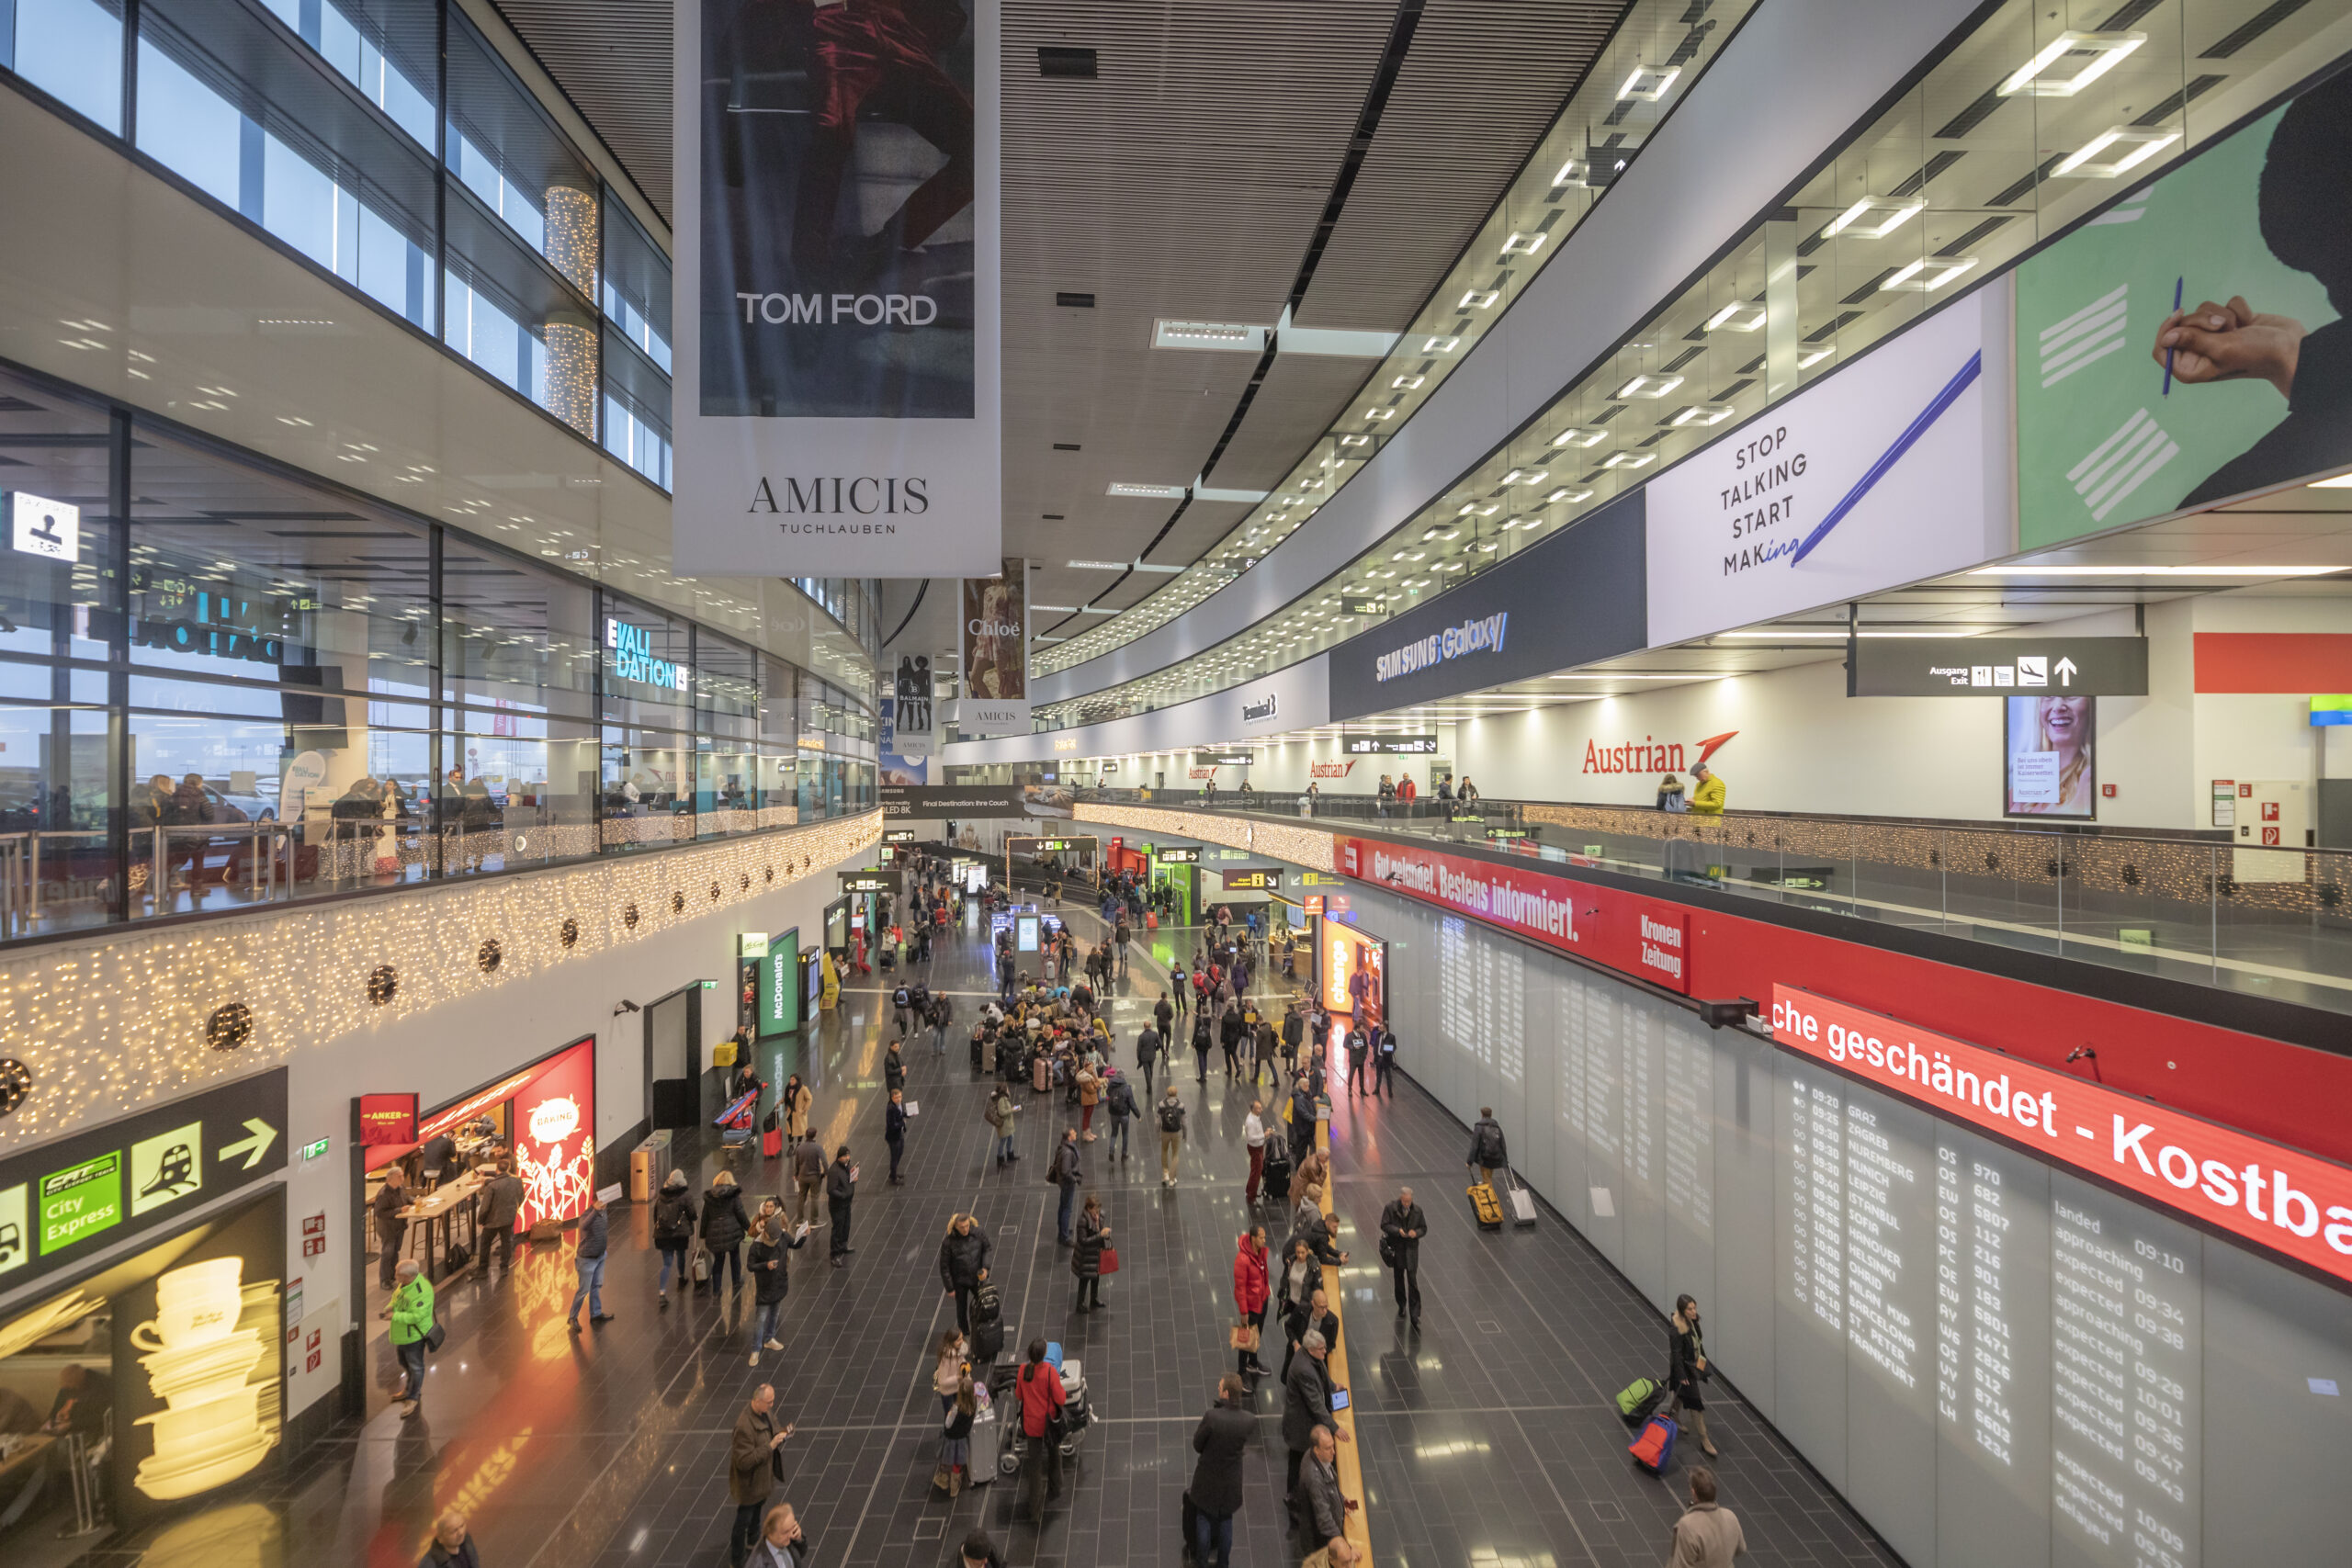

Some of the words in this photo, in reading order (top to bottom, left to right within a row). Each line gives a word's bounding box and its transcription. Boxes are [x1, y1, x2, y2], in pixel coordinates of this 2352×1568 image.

[737, 292, 821, 324] TOM
[831, 294, 938, 326] FORD
[1736, 426, 1787, 469] STOP
[746, 476, 930, 514] AMICIS
[1721, 454, 1807, 510] TALKING
[779, 524, 896, 535] TUCHLAUBEN
[1733, 495, 1792, 539] START
[968, 618, 1021, 637] Chloé
[1376, 635, 1440, 682] SAMSUNG
[1442, 611, 1508, 660] Galaxy
[616, 649, 675, 690] DATION
[1929, 667, 1968, 677] Ausgang
[1951, 677, 1969, 685] Exit
[975, 712, 1016, 721] AMICIS
[1271, 694, 1277, 715] 3
[1188, 766, 1210, 780] Austrian
[1310, 761, 1343, 779] Austrian
[1582, 736, 1685, 774] Austrian
[1374, 851, 1389, 880] Gut
[1391, 856, 1437, 896] gelandet.
[1440, 864, 1488, 912] Bestens
[1492, 877, 1578, 942] informiert.
[1641, 914, 1681, 949] Kronen
[1330, 940, 1349, 1004] change
[1641, 942, 1681, 979] Zeitung
[774, 953, 784, 1020] McDonald's
[1827, 1022, 2058, 1138] geschändet
[370, 1111, 402, 1121] ANKER
[46, 1164, 95, 1190] CAT
[1813, 1088, 1838, 1109] 09:20
[1848, 1105, 1876, 1127] GRAZ
[1939, 1147, 1957, 1165] OS
[1973, 1163, 2000, 1186] 970
[2055, 1201, 2100, 1235] landed
[2134, 1238, 2184, 1274] 09:10
[1813, 1105, 1838, 1126] 09:25
[1848, 1122, 1889, 1151] ZAGREB
[1939, 1167, 1957, 1185] OS
[1973, 1184, 2000, 1207] 682
[2055, 1227, 2143, 1283] approaching
[47, 1195, 84, 1219] City
[48, 1203, 115, 1241] Express
[1813, 1122, 1838, 1143] 09:30
[1849, 1139, 1914, 1183] NUREMBERG
[1939, 1185, 1959, 1204] EW
[1973, 1203, 2010, 1232] 5807
[2055, 1249, 2123, 1293] expected
[2134, 1288, 2184, 1325] 09:34
[1813, 1138, 1839, 1160] 09:30
[1849, 1156, 1890, 1188] MUNICH
[1939, 1205, 1957, 1224] OS
[1974, 1225, 2001, 1249] 112
[2055, 1271, 2123, 1317] expected
[2134, 1314, 2184, 1350] 09:38
[1813, 1154, 1839, 1177] 09:30
[1849, 1174, 1886, 1204] LEIPZIG
[1939, 1225, 1957, 1245] OS
[1974, 1245, 2001, 1269] 216
[2055, 1294, 2143, 1357] approaching
[1813, 1171, 1839, 1194] 09:40
[1849, 1190, 1900, 1231] ISTANBUL
[1939, 1244, 1956, 1264] PC
[1974, 1265, 2001, 1291] 901
[2055, 1315, 2123, 1365] expected
[2134, 1361, 2184, 1401] 09:28
[1813, 1187, 1839, 1211] 09:50
[1849, 1209, 1879, 1235] SOFIA
[1939, 1264, 1957, 1285] OE
[1975, 1286, 2001, 1312] 183
[2055, 1338, 2123, 1389] expected
[2136, 1387, 2184, 1427] 10:01
[1813, 1203, 1839, 1227] 09:55
[1849, 1225, 1902, 1269] HANOVER
[1939, 1282, 1960, 1304] EW
[1974, 1304, 2010, 1339] 5801
[2055, 1361, 2124, 1413] expected
[2134, 1410, 2184, 1452] 09:36
[1814, 1253, 1840, 1279] 10:05
[1849, 1277, 1881, 1309] MILAN
[1887, 1304, 1910, 1327] MXP
[1939, 1342, 1958, 1363] OS
[1974, 1366, 2001, 1396] 512
[1814, 1220, 1839, 1245] 10:00
[1849, 1243, 1896, 1283] HELSINKI
[1939, 1303, 1957, 1323] AY
[1975, 1326, 2010, 1360] 1471
[2056, 1383, 2124, 1437] expected
[1814, 1236, 1840, 1261] 10:00
[1849, 1260, 1882, 1291] OHRID
[1939, 1322, 1961, 1346] W6
[1974, 1347, 2011, 1381] 2826
[2056, 1405, 2124, 1461] expected
[1814, 1286, 1840, 1313] 10:10
[1849, 1312, 1866, 1332] ST.
[1871, 1328, 1909, 1365] PETER.
[1974, 1408, 2011, 1444] 6603
[2056, 1472, 2124, 1532] expected
[1814, 1269, 1840, 1296] 10:05
[1849, 1294, 1916, 1352] BARCELONA
[1974, 1387, 2011, 1424] 8714
[2056, 1450, 2124, 1508] expected
[2136, 1508, 2184, 1552] 10:09
[1814, 1303, 1840, 1329] 10:10
[1849, 1329, 1916, 1388] FRANKFURT
[1939, 1400, 1956, 1422] LH
[1975, 1428, 2011, 1466] 1234
[2056, 1495, 2109, 1546] delayed
